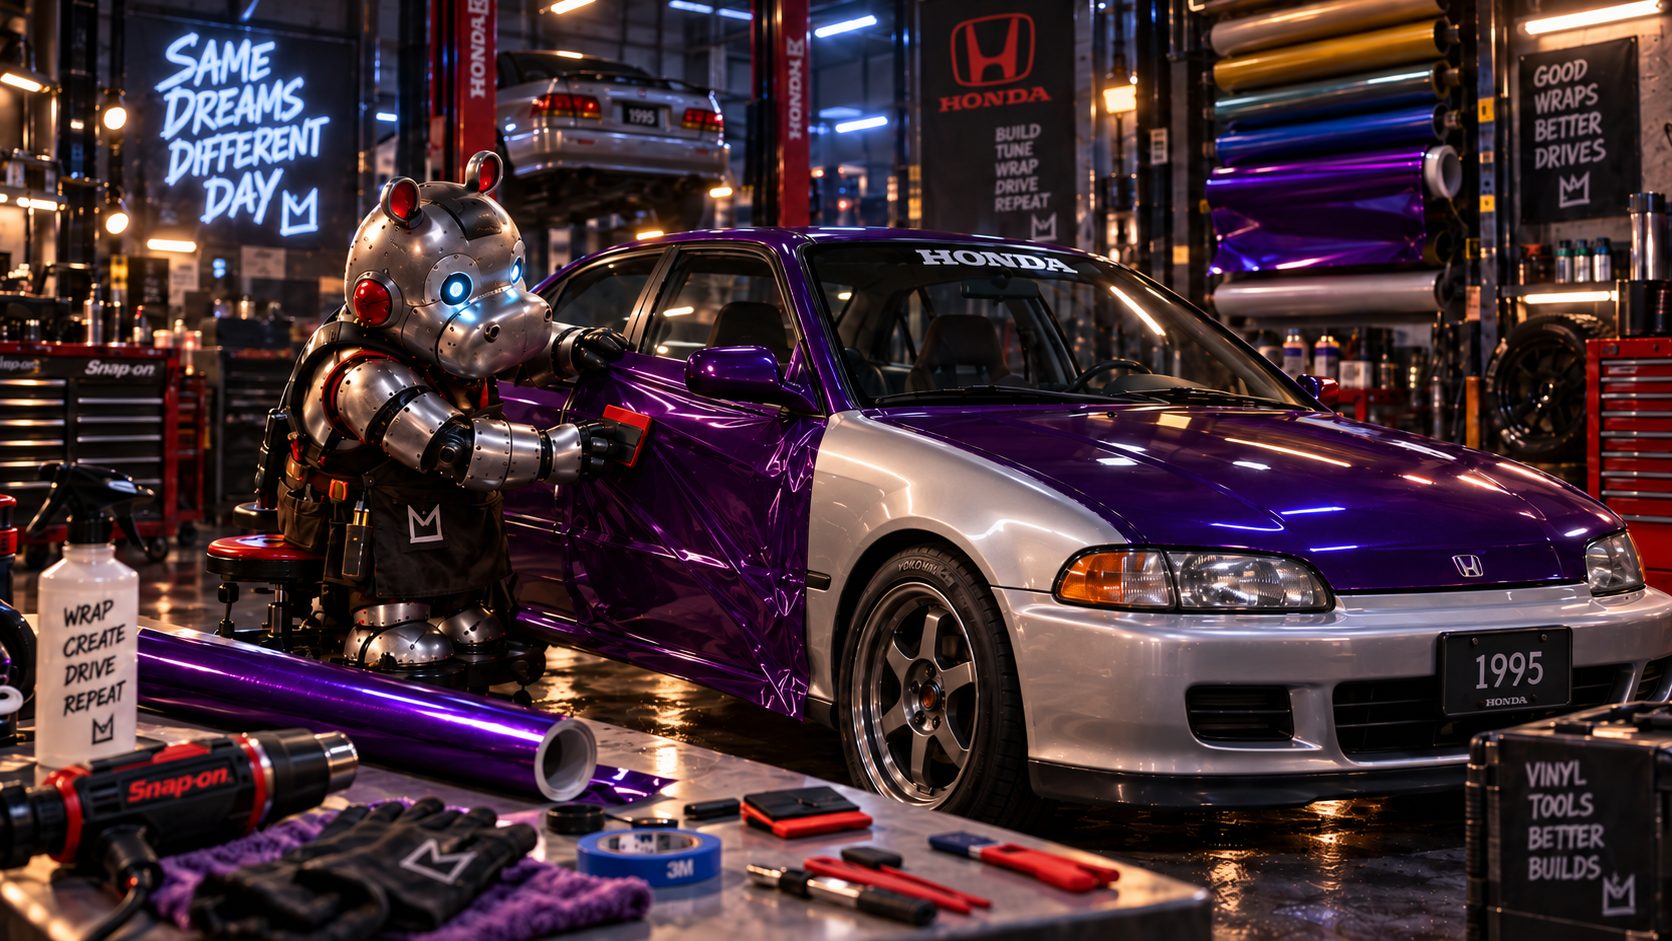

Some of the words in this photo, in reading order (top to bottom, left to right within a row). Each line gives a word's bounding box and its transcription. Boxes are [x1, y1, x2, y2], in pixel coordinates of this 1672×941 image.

[154, 32, 276, 92] SAME
[470, 15, 486, 98] HONDA
[1533, 59, 1588, 87] GOOD
[160, 76, 304, 140] DREAMS
[939, 86, 1051, 112] HONDA
[1534, 82, 1599, 115] WRAPS
[628, 108, 656, 125] 1995
[1535, 111, 1603, 143] BETTER
[995, 123, 1042, 142] BUILD
[164, 116, 331, 186] DIFFERENT
[994, 140, 1035, 159] TUNE
[1535, 138, 1607, 169] DRIVES
[994, 158, 1040, 177] WRAP
[200, 167, 284, 225] DAY
[995, 176, 1039, 195] DRIVE
[994, 191, 1052, 213] REPEAT
[915, 249, 1079, 274] HONDA
[84, 359, 156, 378] Snap-on
[64, 599, 114, 627] WRAP
[63, 624, 126, 657] CREATE
[64, 655, 117, 687] DRIVE
[1475, 651, 1544, 689] 1995
[63, 680, 126, 717] REPEAT
[1486, 696, 1528, 707] HONDA
[127, 767, 228, 803] Snap-on
[1525, 760, 1588, 788] VINYL
[1527, 792, 1595, 821] TOOLS
[1528, 823, 1605, 851] BETTER
[666, 859, 694, 879] 3M
[1528, 855, 1602, 881] BUILDS
